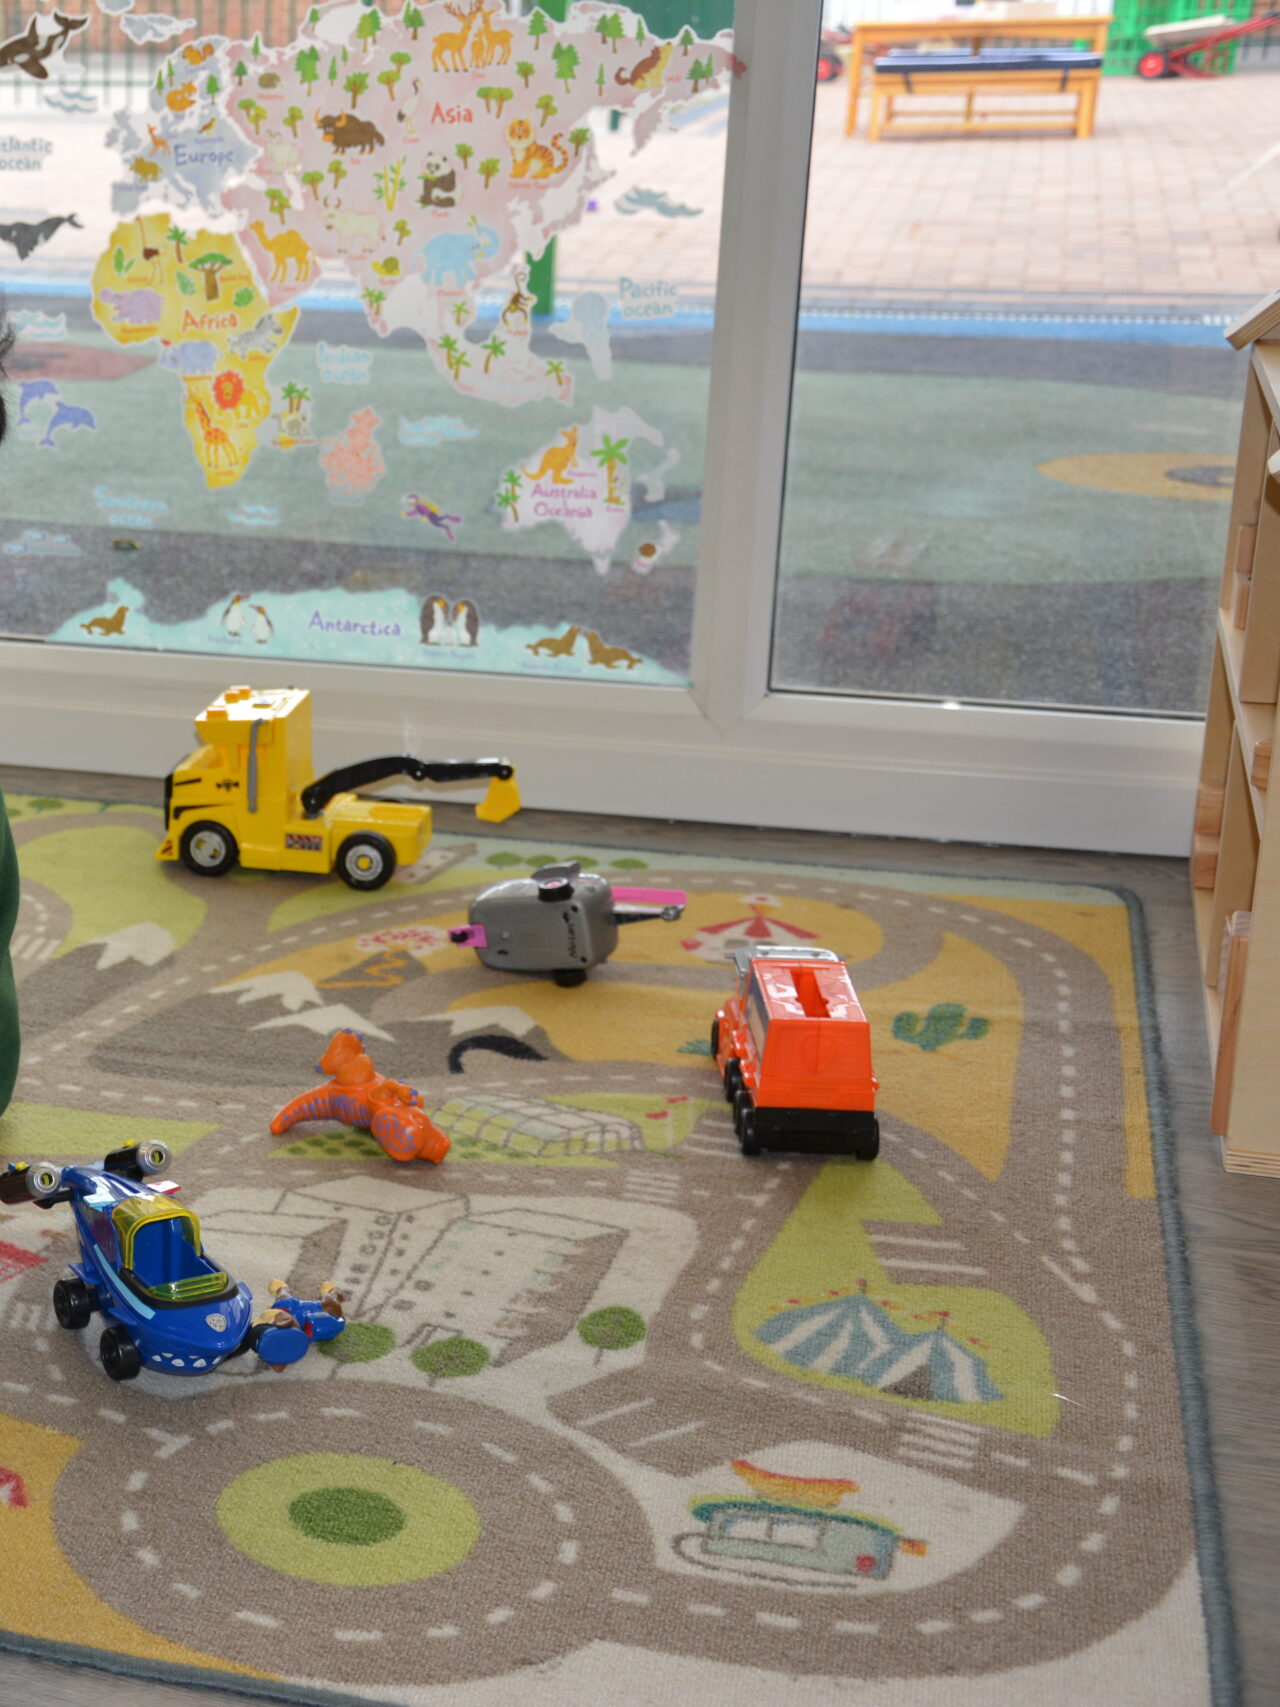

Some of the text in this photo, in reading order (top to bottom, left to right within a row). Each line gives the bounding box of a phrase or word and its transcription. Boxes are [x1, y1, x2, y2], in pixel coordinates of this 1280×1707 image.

[431, 101, 474, 124] Asia
[174, 144, 234, 166] Europe
[620, 277, 678, 298] Pacific
[624, 302, 673, 317] ocean
[182, 309, 237, 332] Africa
[531, 483, 597, 499] Australia
[534, 502, 592, 518] Oceania
[308, 611, 402, 636] Antarctica
